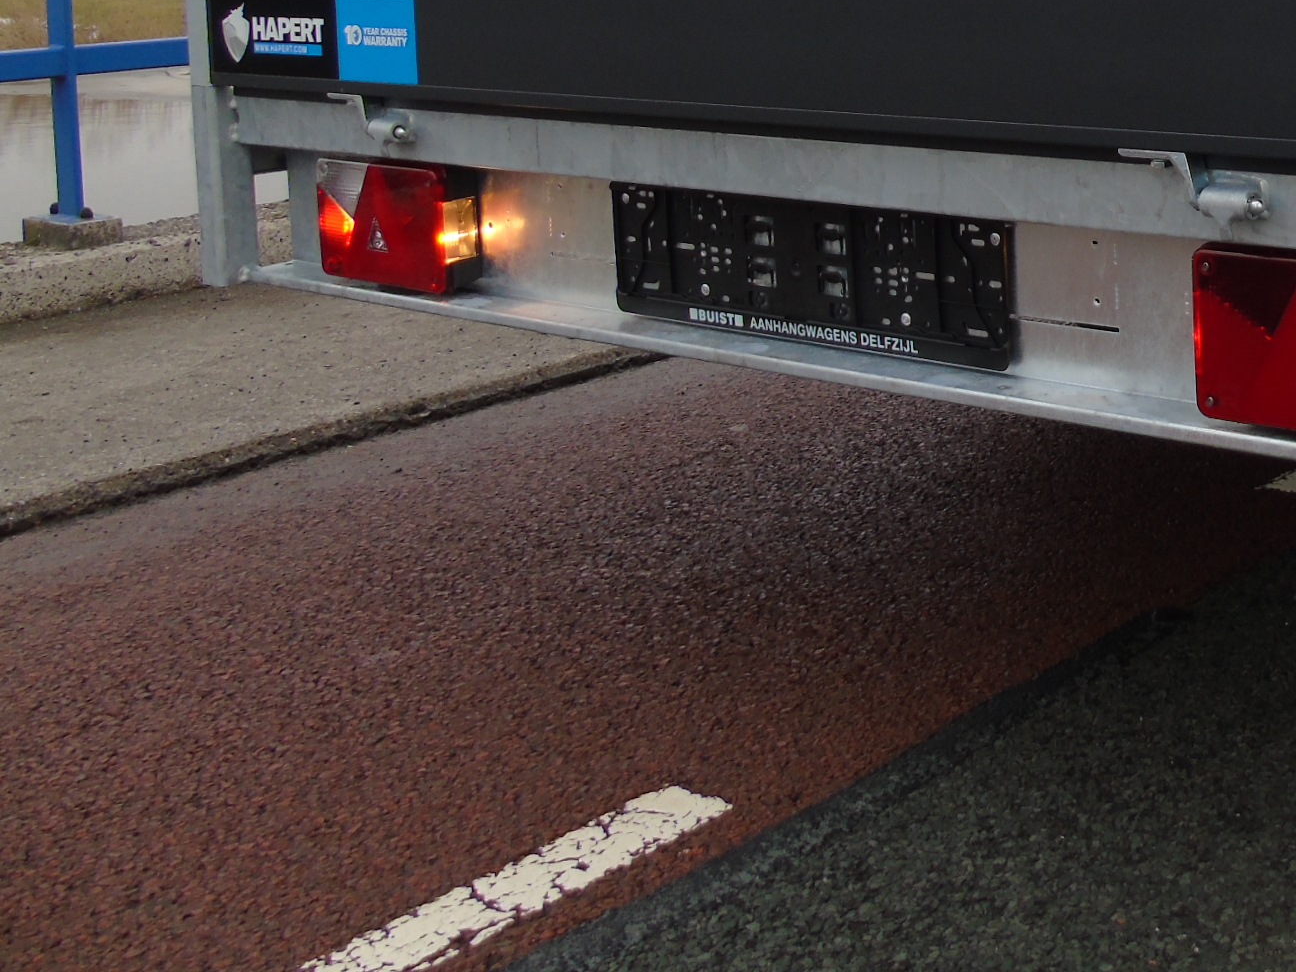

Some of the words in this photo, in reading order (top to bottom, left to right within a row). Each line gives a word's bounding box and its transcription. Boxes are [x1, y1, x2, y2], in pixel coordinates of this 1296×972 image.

[251, 16, 325, 43] HAPERT
[344, 24, 363, 46] 10
[363, 26, 379, 36] YEAR
[380, 27, 408, 37] CHASSIS
[363, 35, 408, 47] WARRANTY
[698, 308, 734, 325] BUIST
[750, 317, 857, 344] AANHANGWAGENS
[860, 332, 919, 354] DELFZIJL
